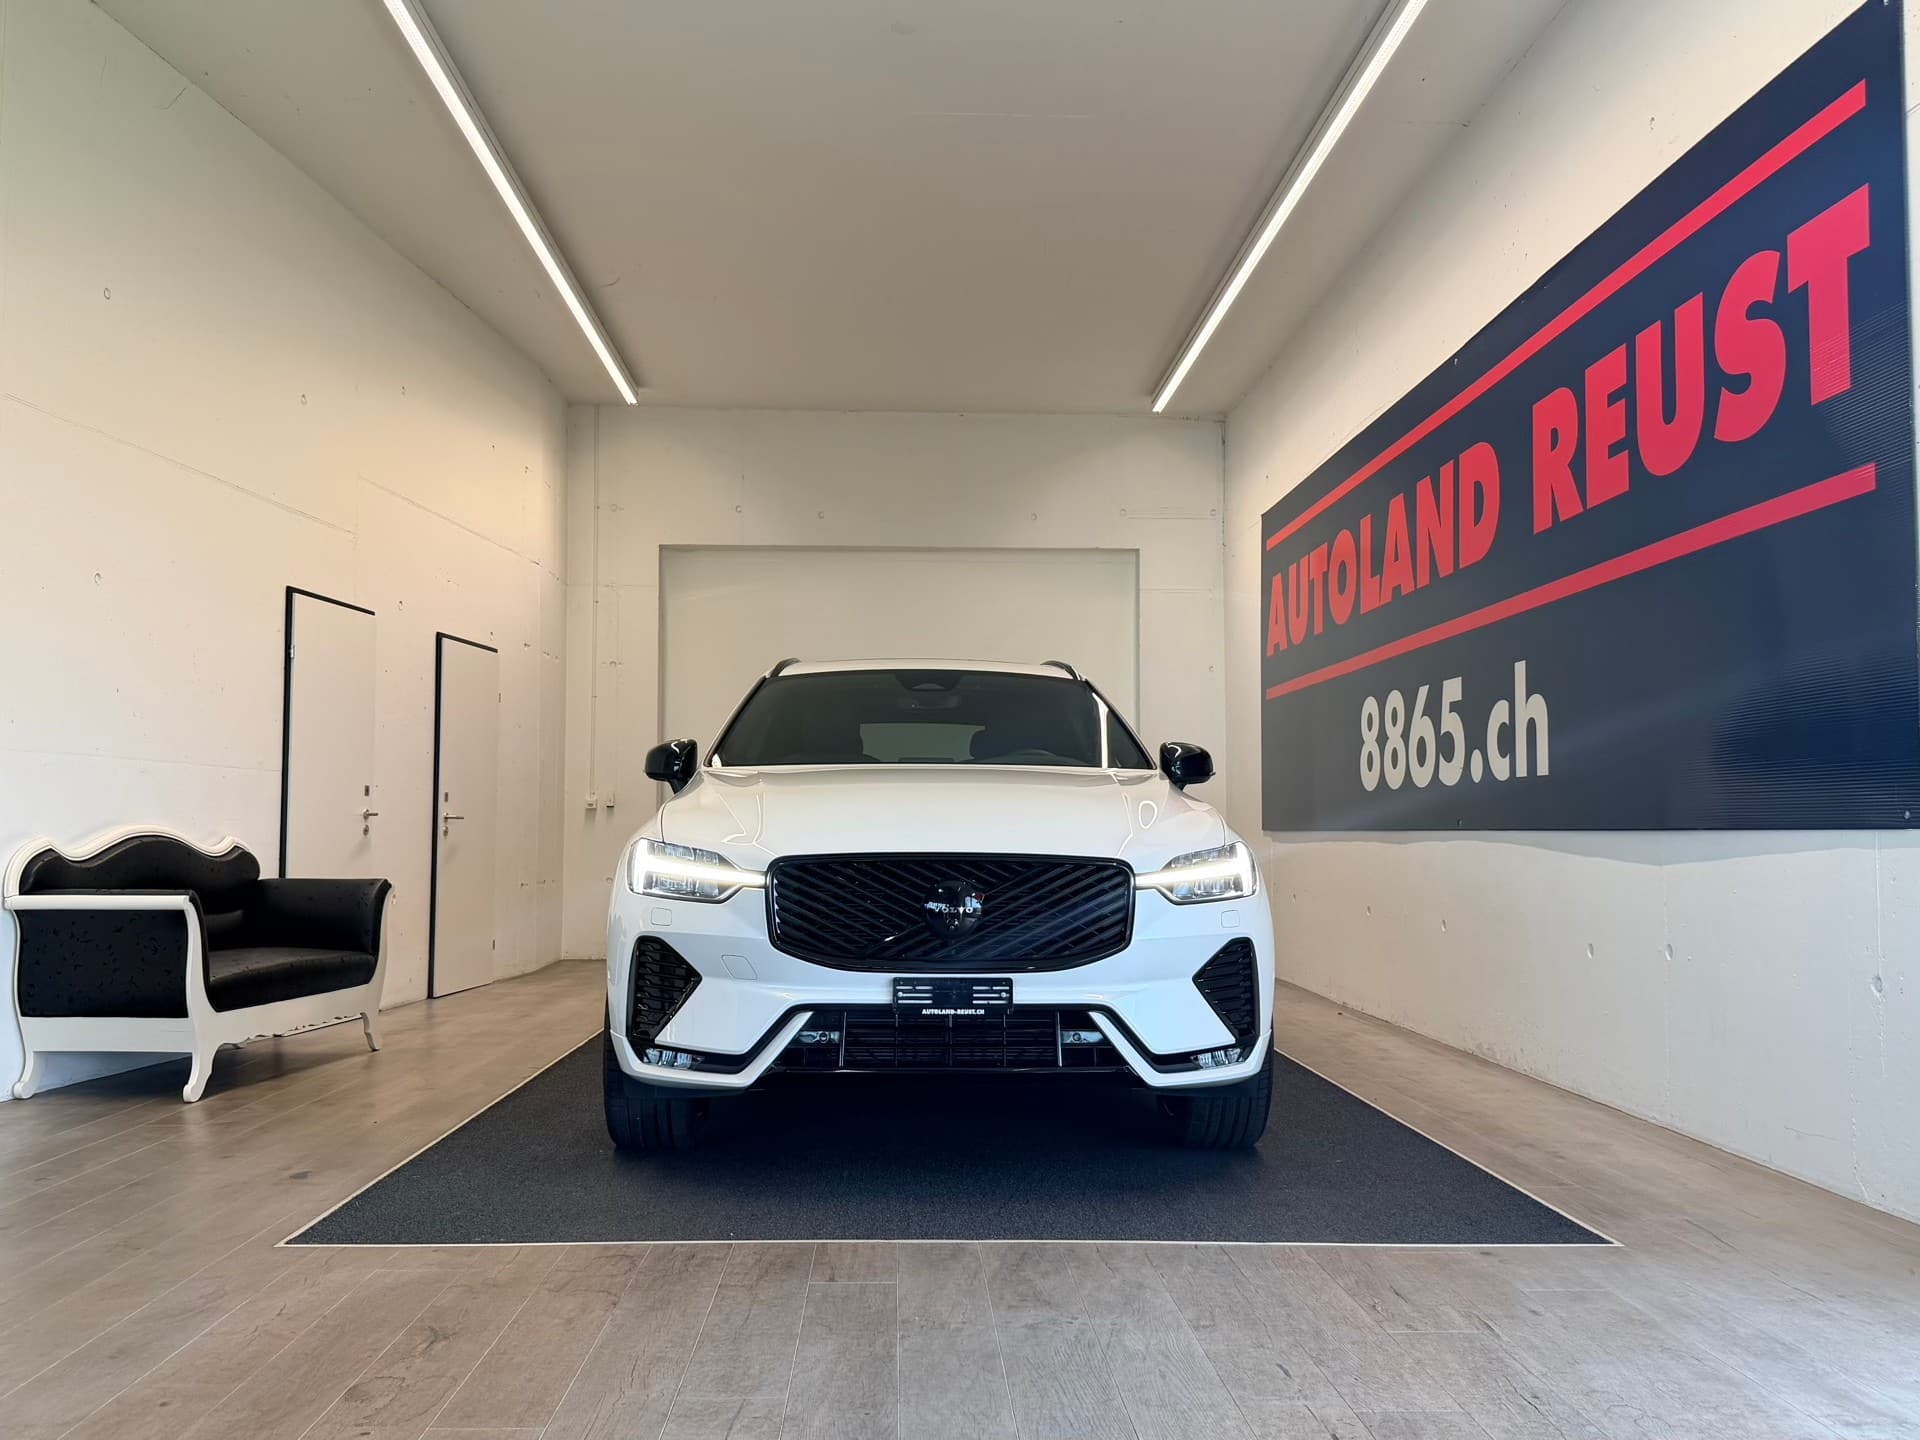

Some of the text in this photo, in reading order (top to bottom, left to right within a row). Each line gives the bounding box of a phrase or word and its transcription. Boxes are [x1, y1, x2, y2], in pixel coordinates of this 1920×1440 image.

[1266, 183, 1870, 657] AUTOLAND REUST
[1360, 660, 1549, 791] 8865.ch
[934, 906, 974, 914] VOLVO
